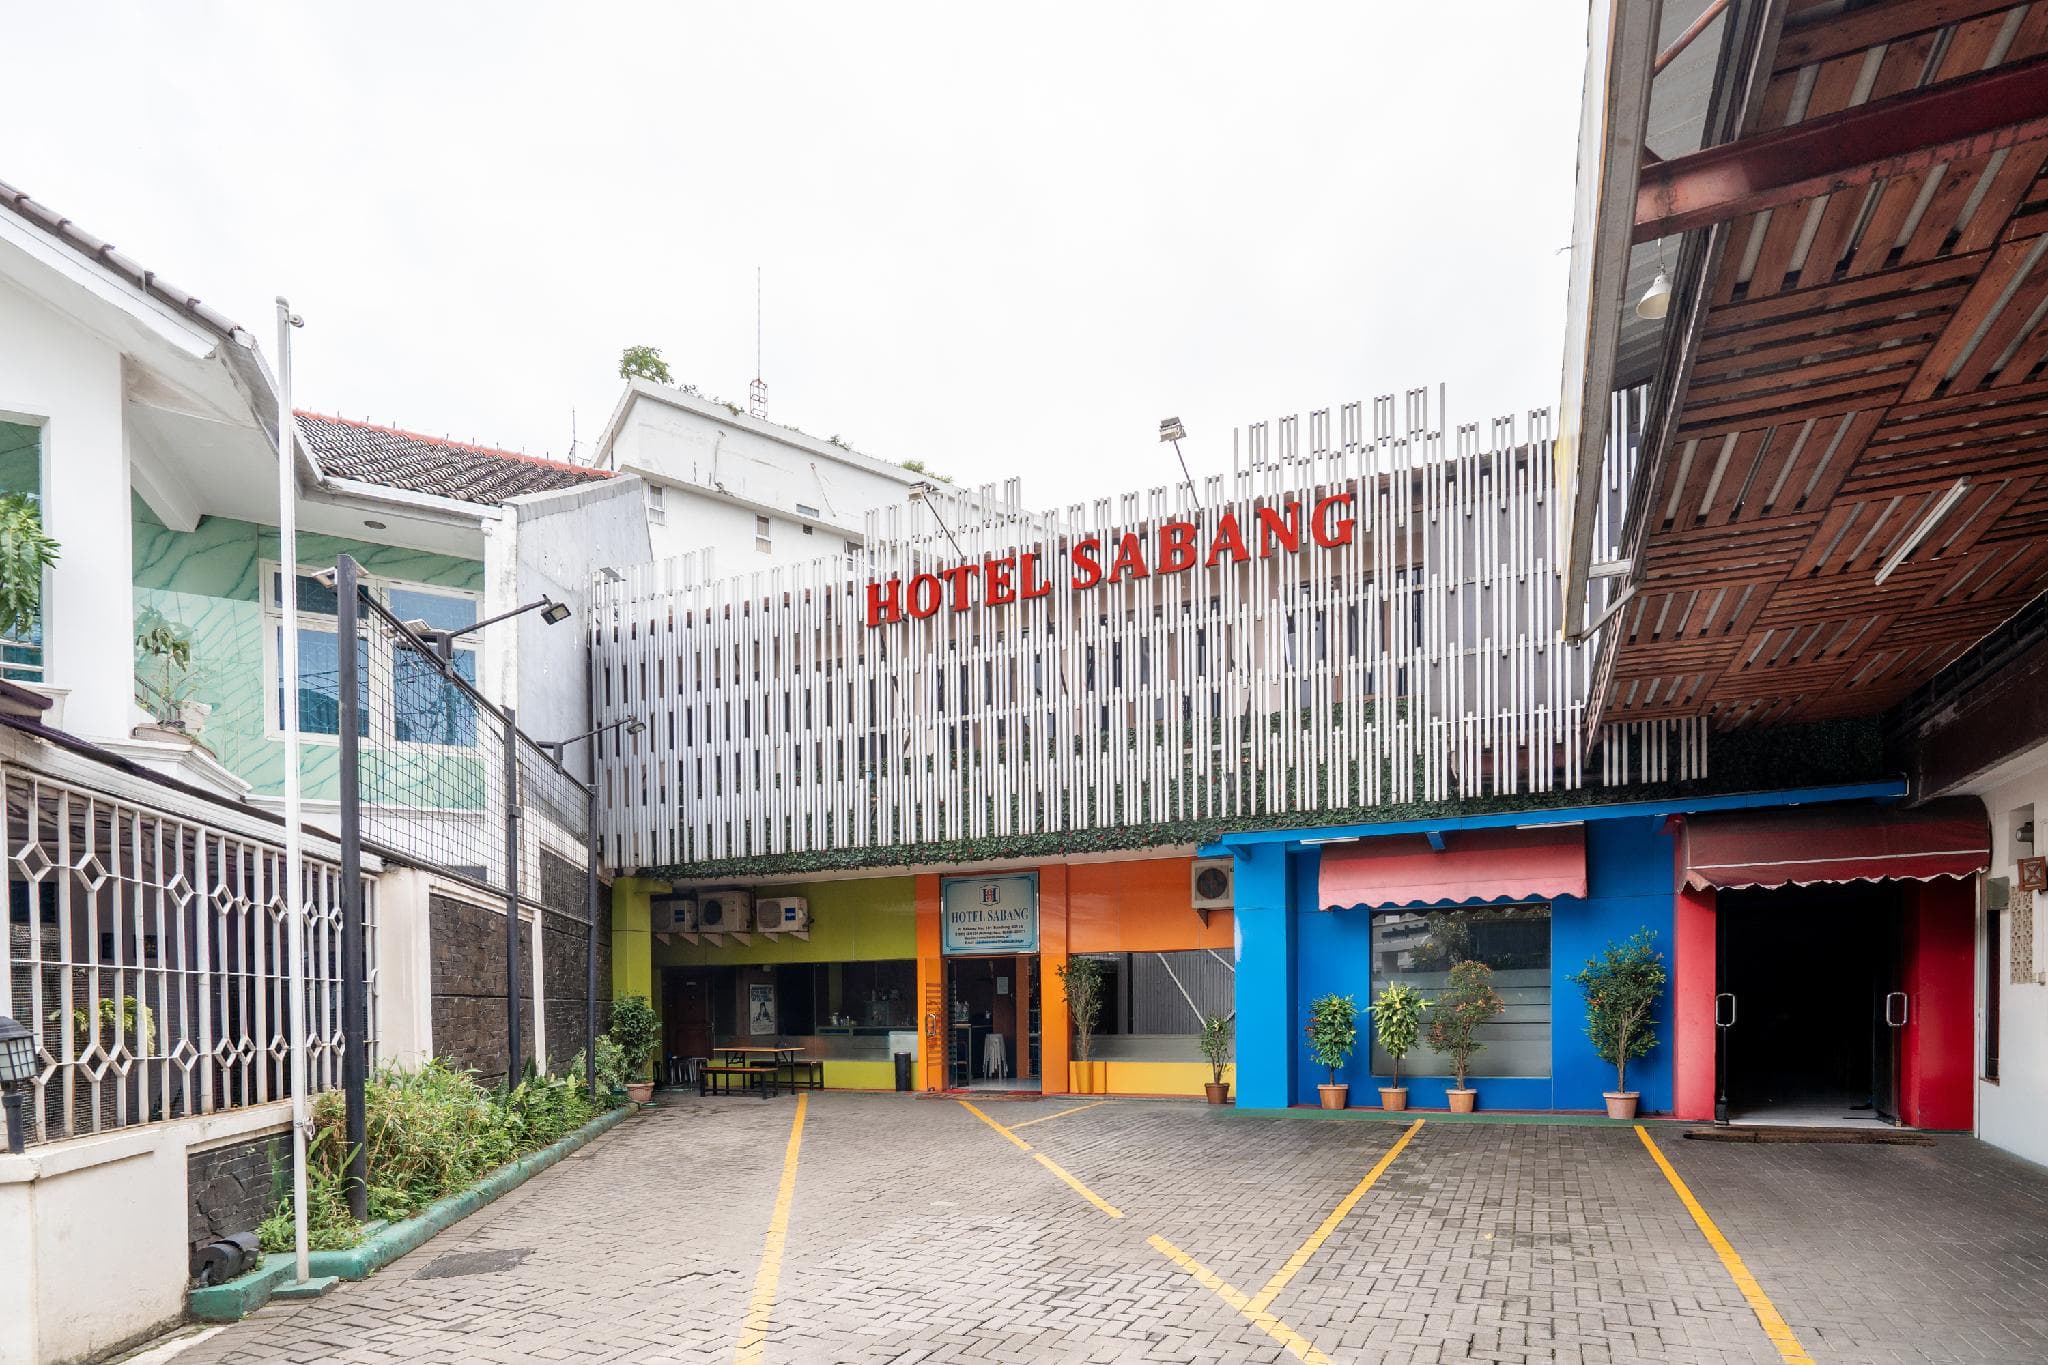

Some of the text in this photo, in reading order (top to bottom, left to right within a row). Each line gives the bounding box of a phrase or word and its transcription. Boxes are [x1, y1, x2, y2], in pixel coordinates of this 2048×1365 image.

[866, 493, 1356, 628] HOTEL SABANG
[951, 907, 1029, 924] HOTEL SABANG
